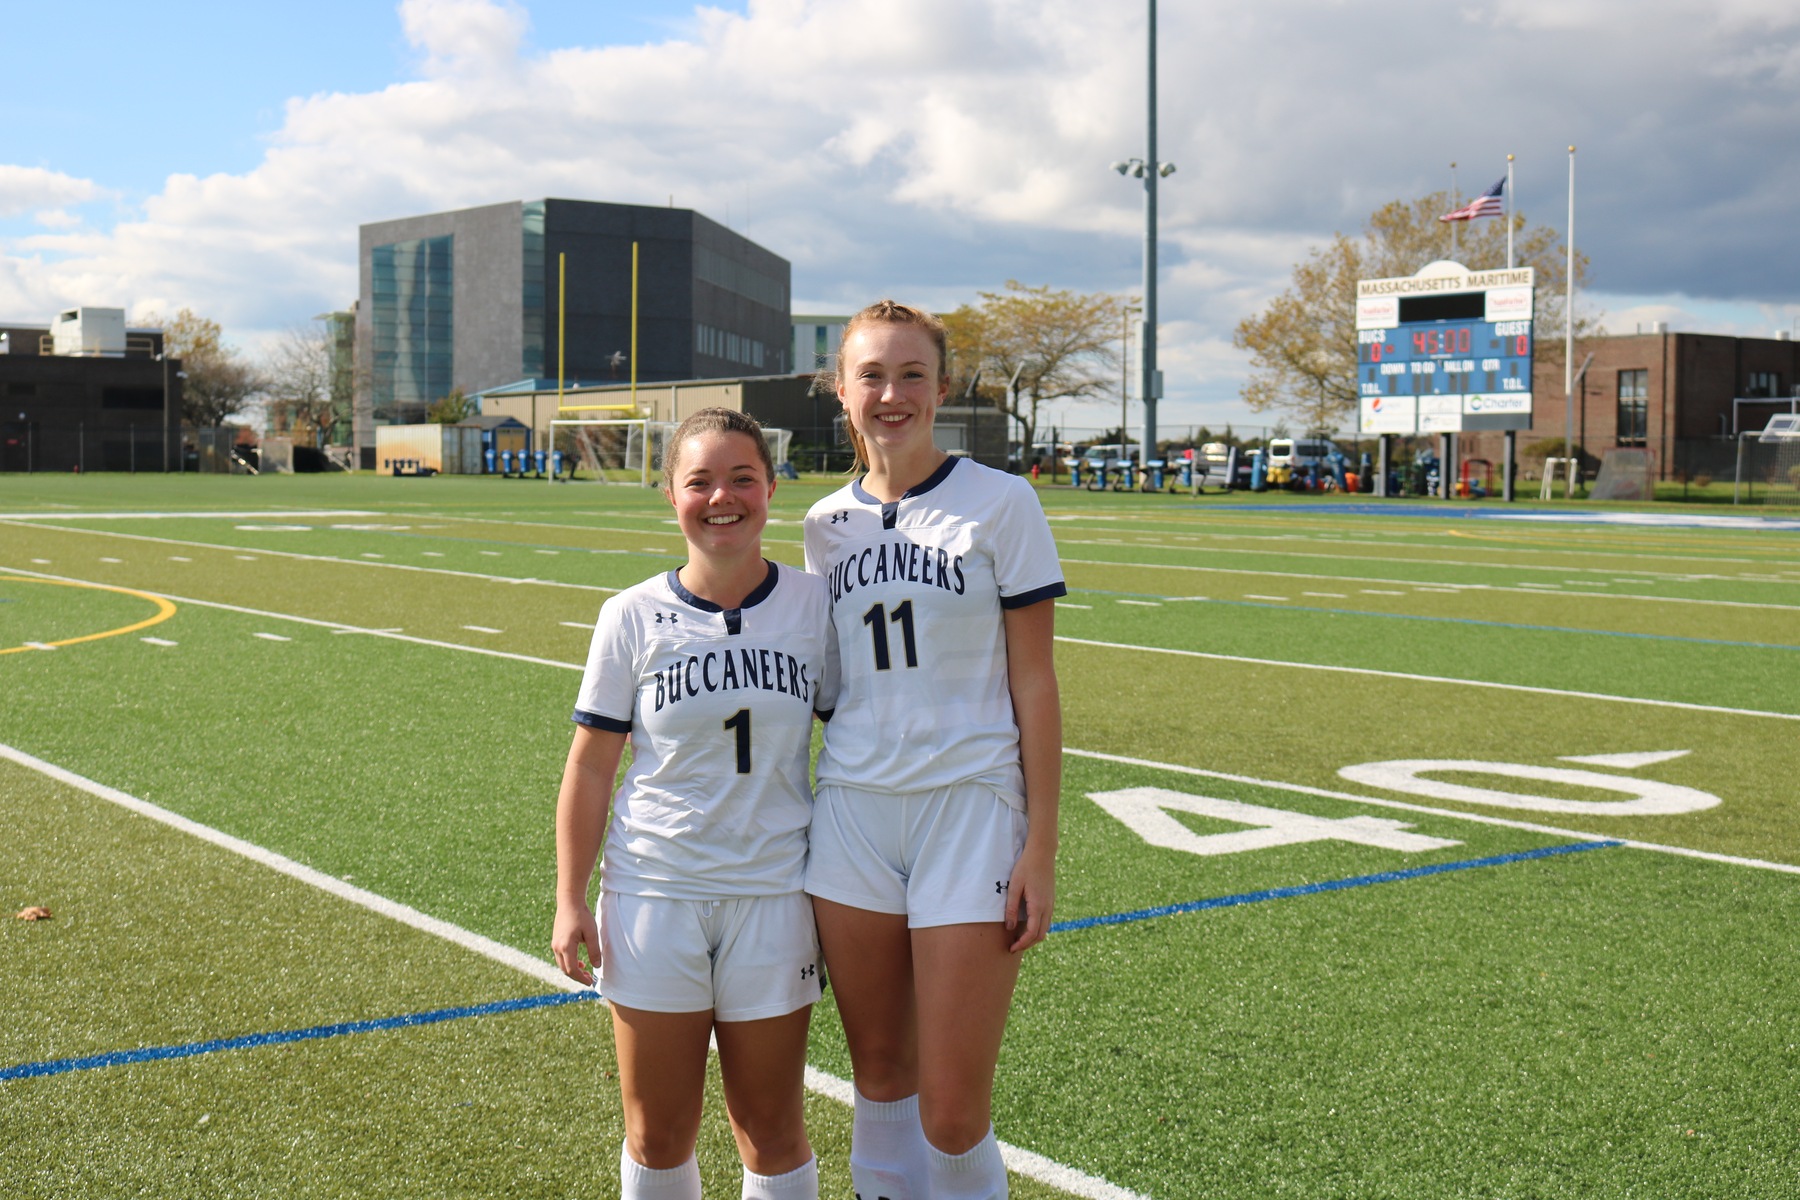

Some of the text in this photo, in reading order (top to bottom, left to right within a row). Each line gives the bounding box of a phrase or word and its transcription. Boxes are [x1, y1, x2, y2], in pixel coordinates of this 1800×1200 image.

[1361, 271, 1529, 295] MASSACHUSETTS MARITIME
[1358, 329, 1386, 344] BUCS
[1495, 320, 1531, 337] GUEST
[1413, 328, 1470, 354] 45:00
[1380, 362, 1406, 375] DOWN
[1483, 398, 1523, 409] Charter
[863, 598, 918, 672] 11
[654, 648, 808, 712] BUCCANEERS
[722, 706, 752, 775] 1
